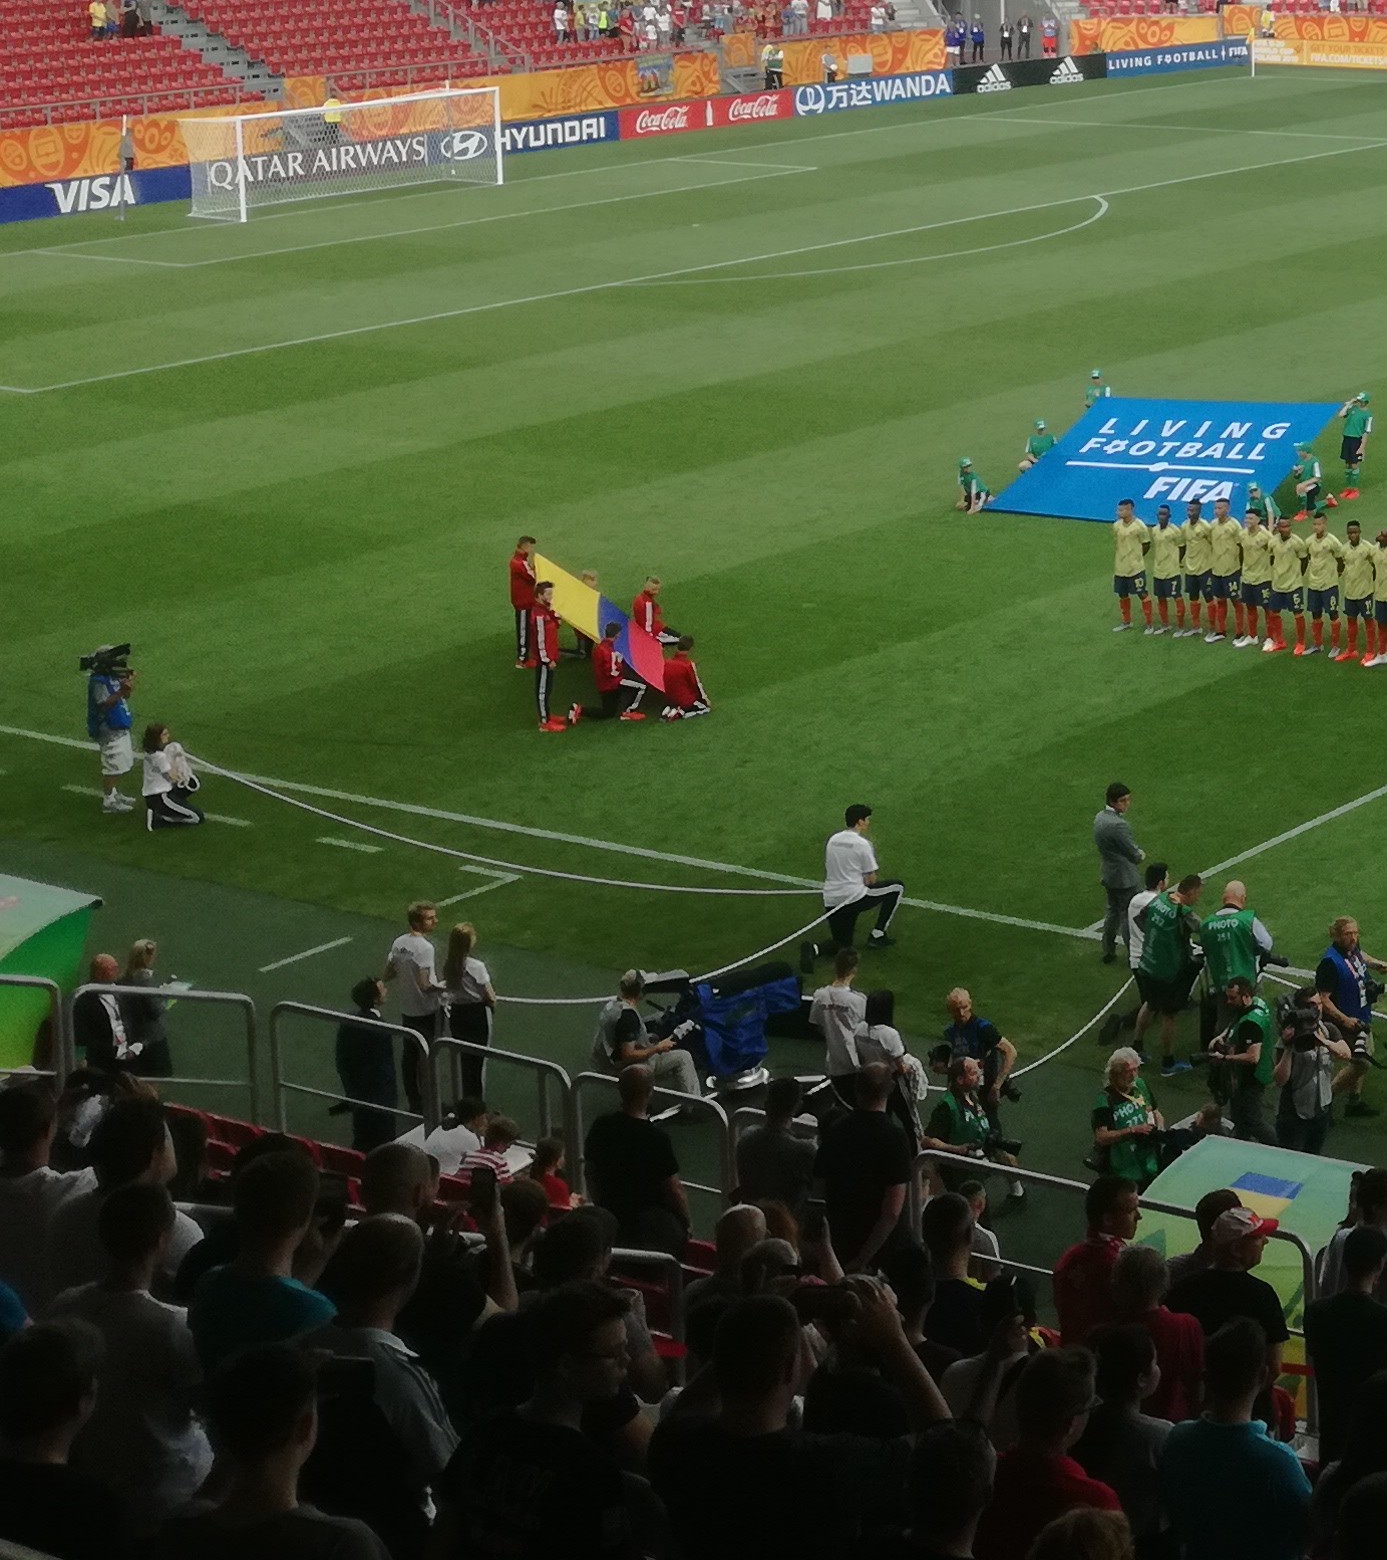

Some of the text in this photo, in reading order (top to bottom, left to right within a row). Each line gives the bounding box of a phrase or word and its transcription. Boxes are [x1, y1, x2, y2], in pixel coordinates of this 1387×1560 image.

[1108, 55, 1152, 70] LIVING
[1228, 45, 1249, 58] FIFA
[872, 72, 951, 101] WANDA
[977, 80, 1012, 93] adidas
[1049, 72, 1085, 85] adidas
[499, 117, 605, 153] HYUNDAI
[209, 136, 426, 192] QATAR AIRWAYS
[50, 175, 135, 213] VISA
[1099, 418, 1291, 440] LIVING
[1143, 476, 1235, 503] FIFA
[1208, 918, 1239, 931] PHOTO
